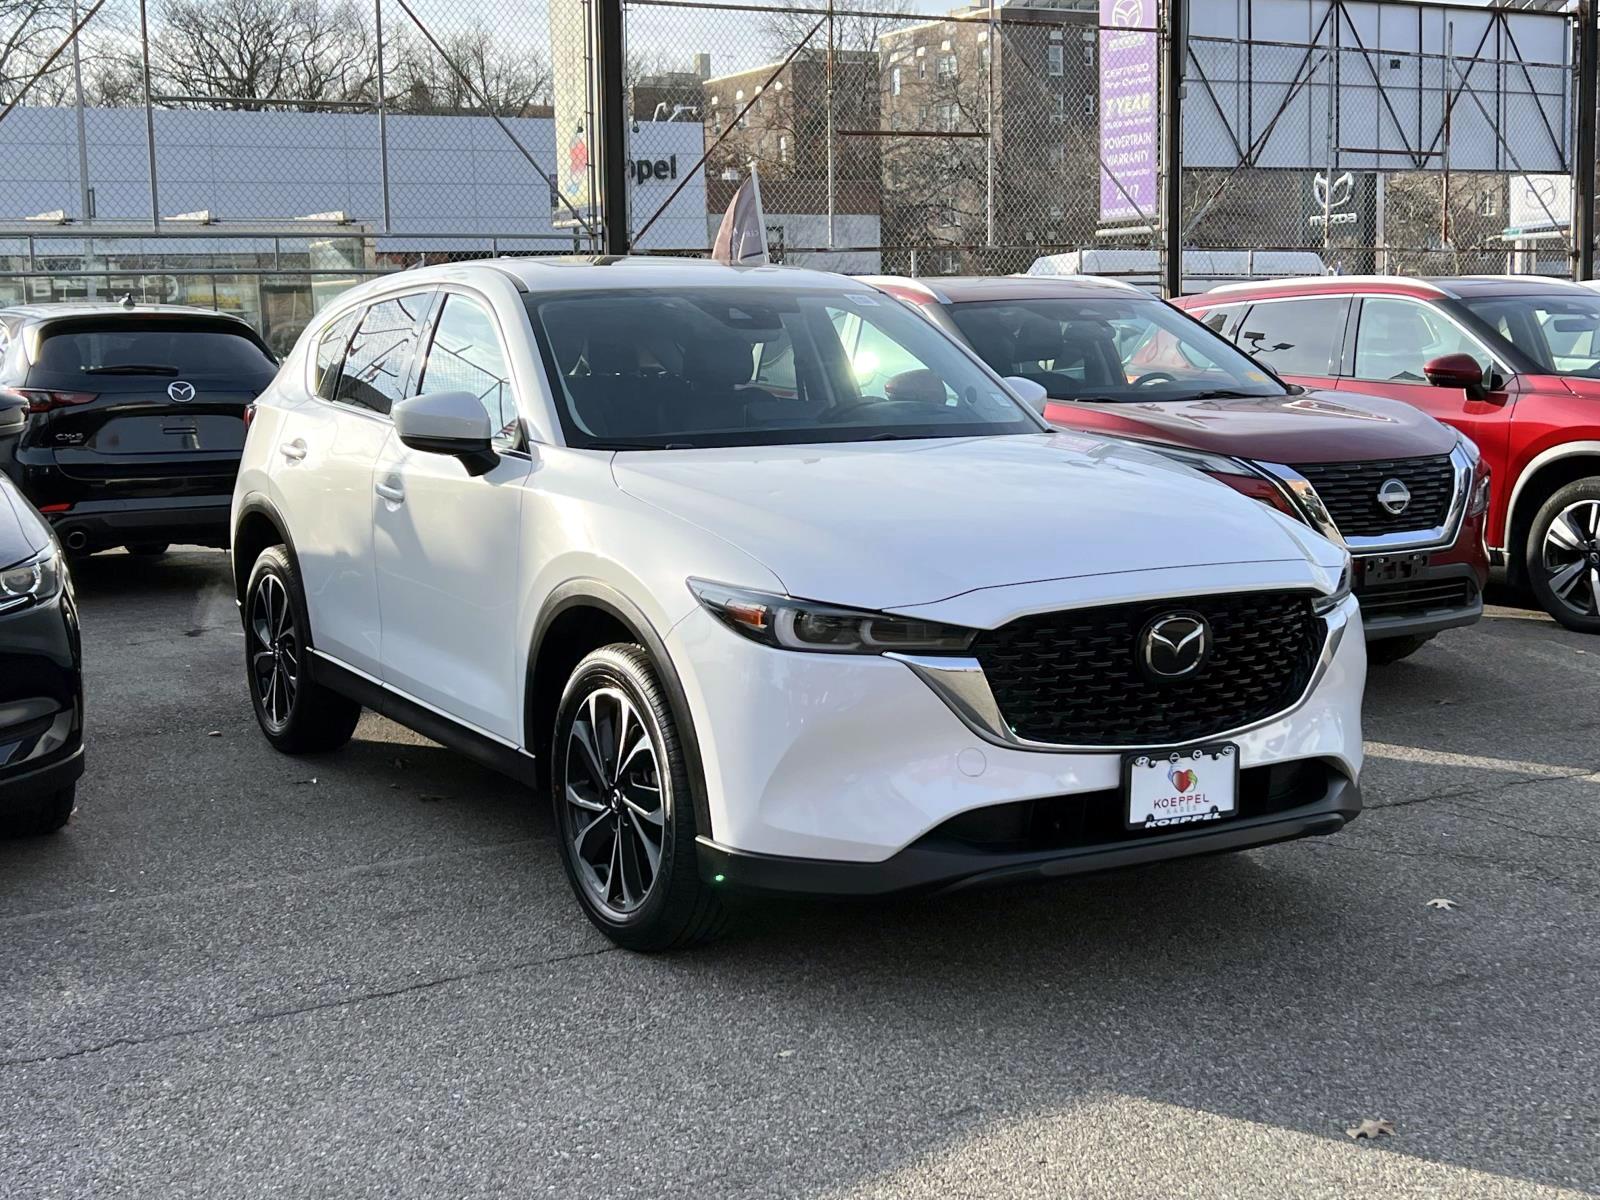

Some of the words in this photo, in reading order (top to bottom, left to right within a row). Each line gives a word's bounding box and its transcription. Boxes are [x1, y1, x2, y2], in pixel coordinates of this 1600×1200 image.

[1116, 92, 1151, 114] YEAR
[1104, 132, 1152, 149] POWERTRAIN
[1106, 150, 1149, 166] WARRANTY
[1153, 794, 1209, 809] KOEPPEL
[1145, 812, 1221, 828] KOEPPEL
